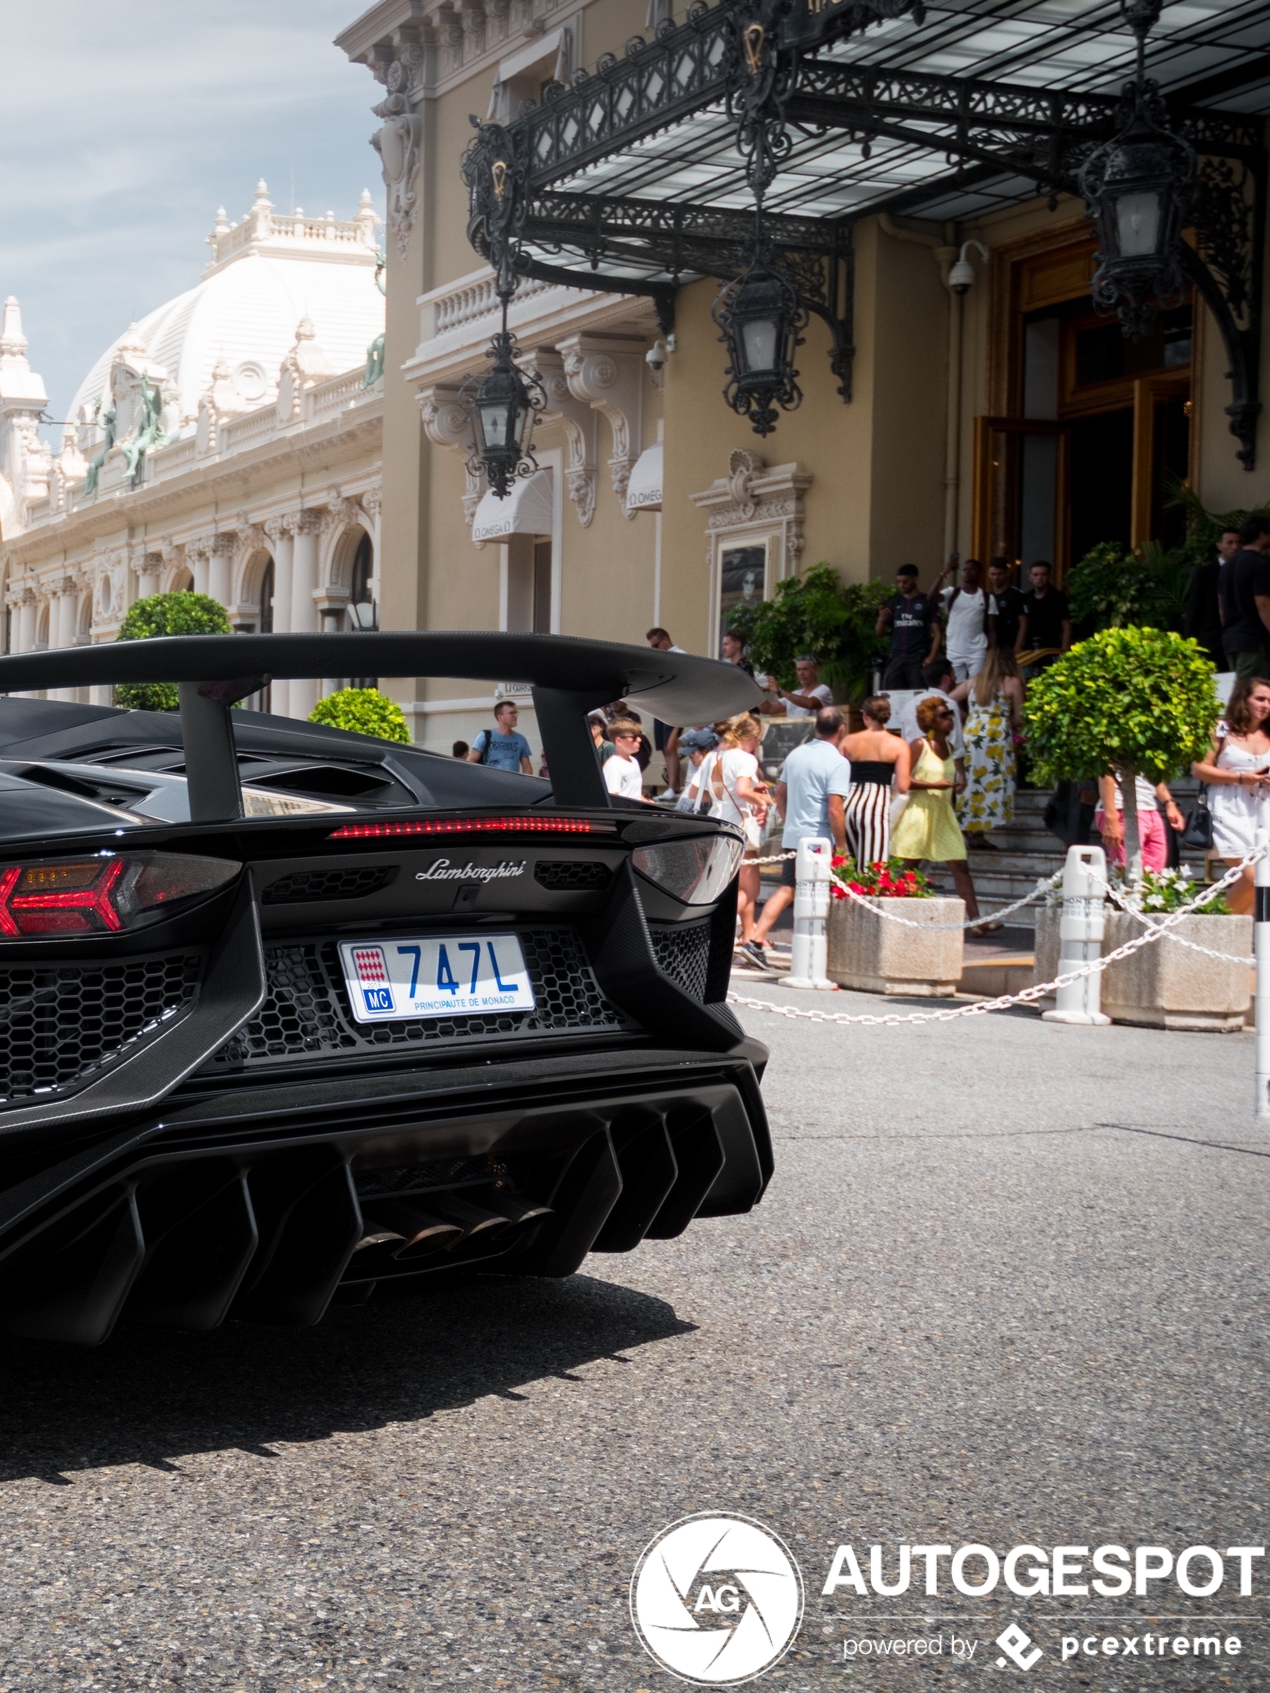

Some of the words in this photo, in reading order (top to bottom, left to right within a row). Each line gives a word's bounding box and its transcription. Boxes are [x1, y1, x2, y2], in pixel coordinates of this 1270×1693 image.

[638, 489, 662, 504] OMEG
[481, 524, 503, 538] OMEGA
[415, 858, 527, 884] Lamborghini
[397, 942, 519, 999] 747L
[368, 991, 389, 1009] MC
[414, 998, 467, 1011] PRINCIPAUTE
[469, 997, 480, 1007] DE
[482, 995, 515, 1006] MONACO
